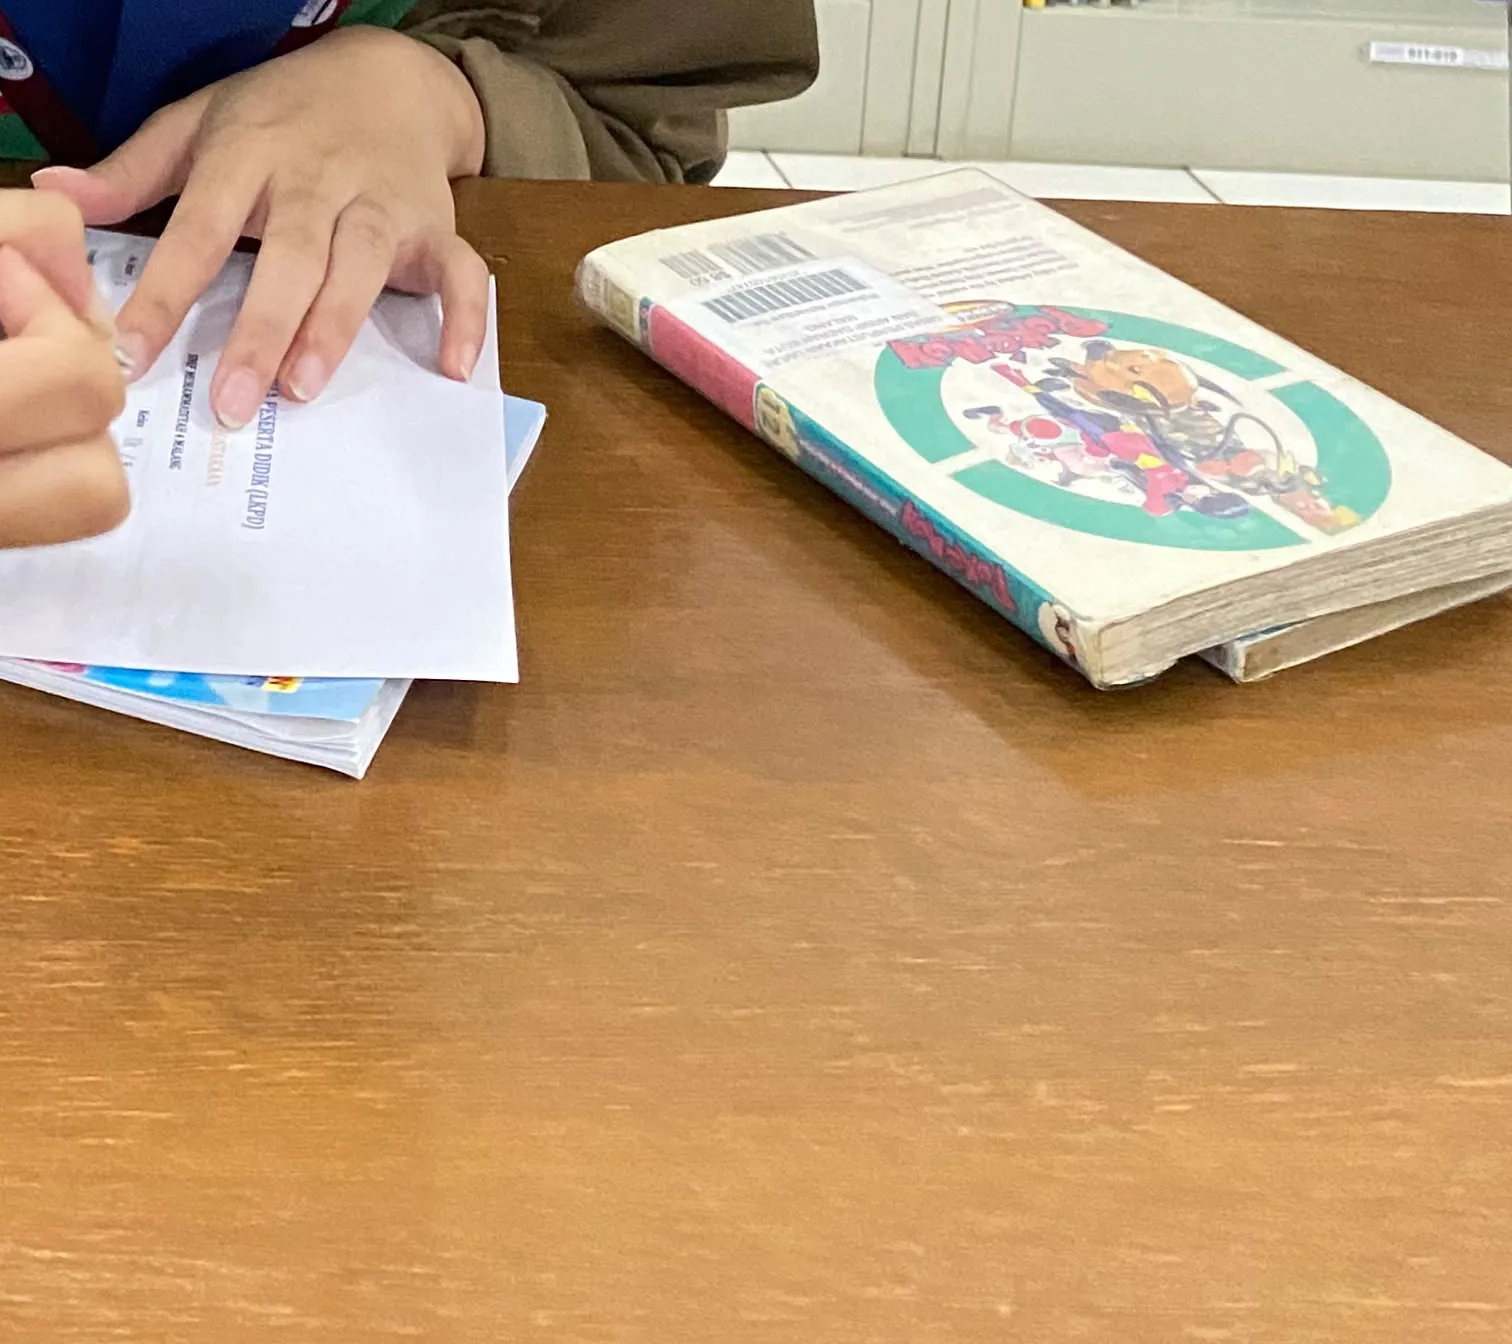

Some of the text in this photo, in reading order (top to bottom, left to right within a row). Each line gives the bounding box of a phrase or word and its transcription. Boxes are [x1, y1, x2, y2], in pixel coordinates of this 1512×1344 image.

[255, 400, 278, 451] PESERTA
[249, 450, 274, 488] DIDIK
[241, 484, 269, 531] (LKPD)
